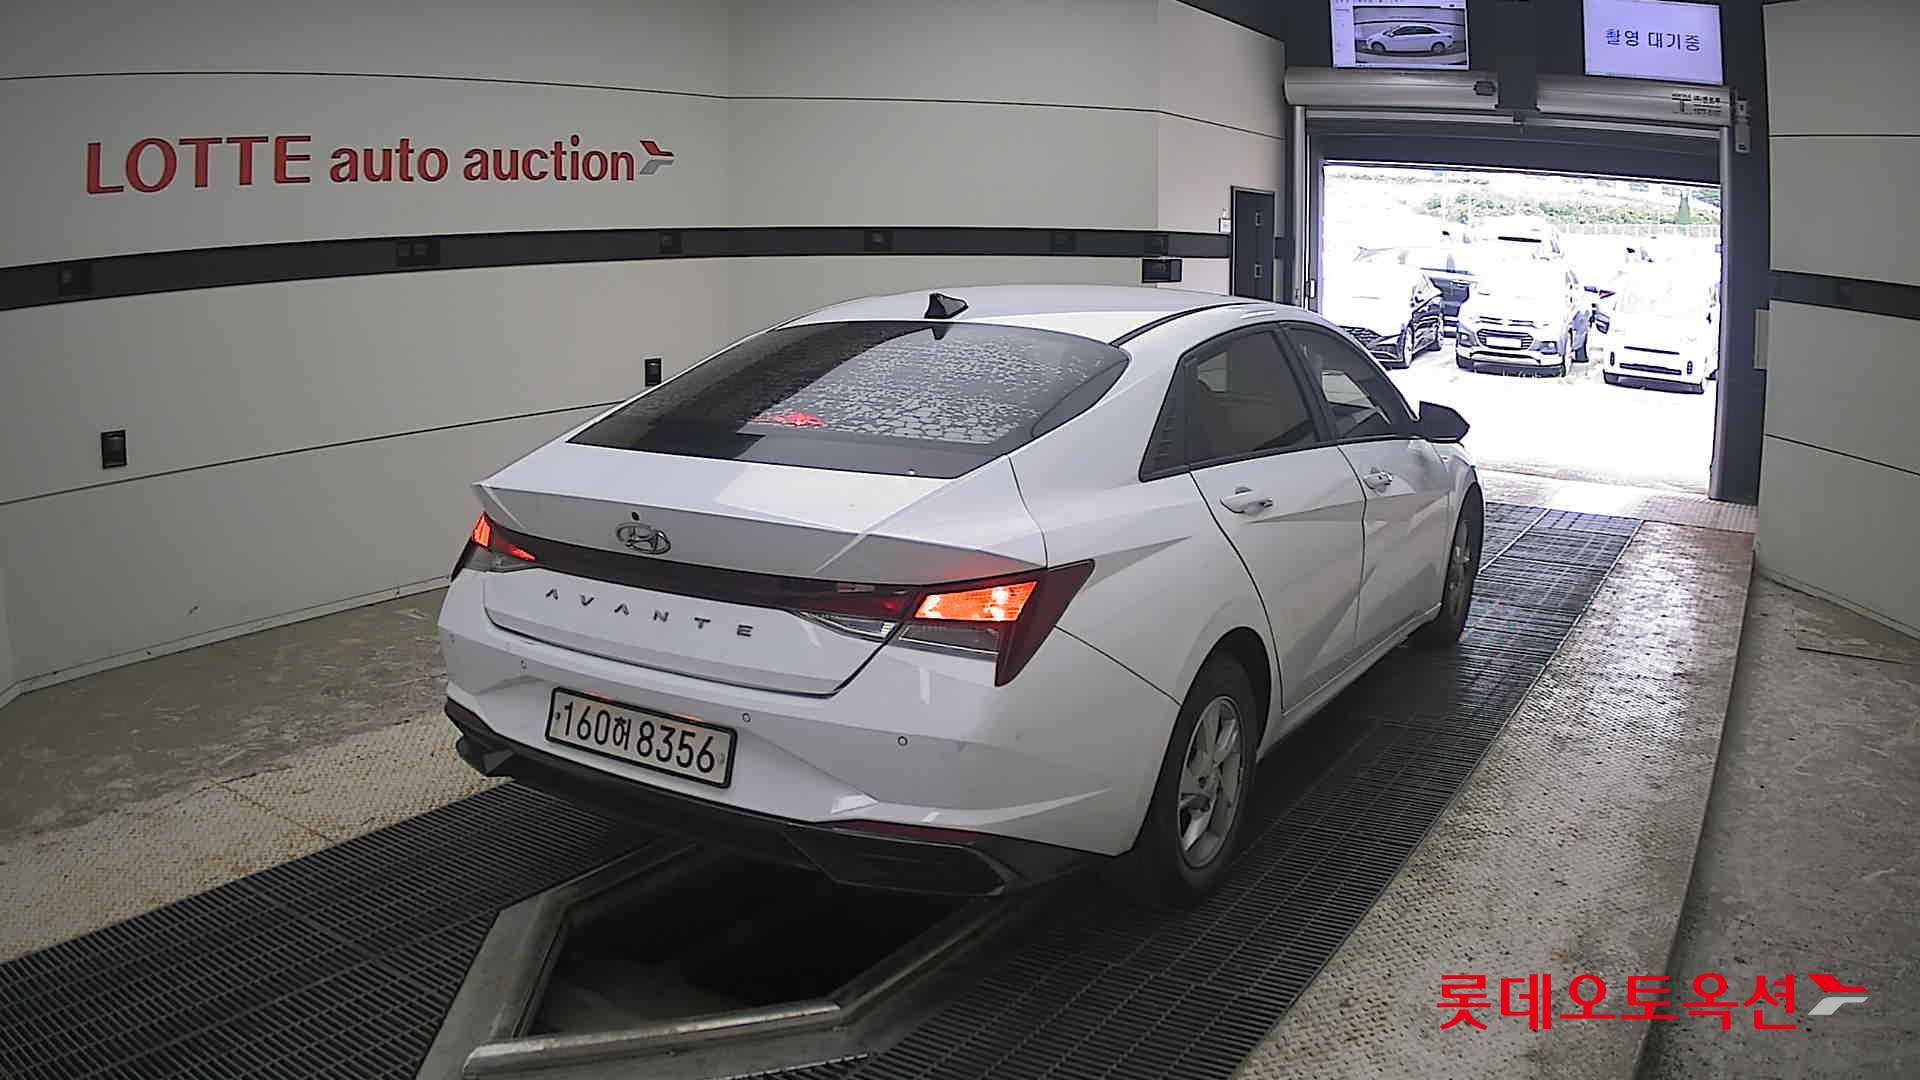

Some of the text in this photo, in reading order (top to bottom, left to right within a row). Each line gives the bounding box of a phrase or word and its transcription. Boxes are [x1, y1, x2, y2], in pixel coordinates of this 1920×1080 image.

[1606, 28, 1700, 52] 촬영 대기중
[86, 134, 635, 194] LOTTE auto auction
[545, 588, 754, 638] AVANTE
